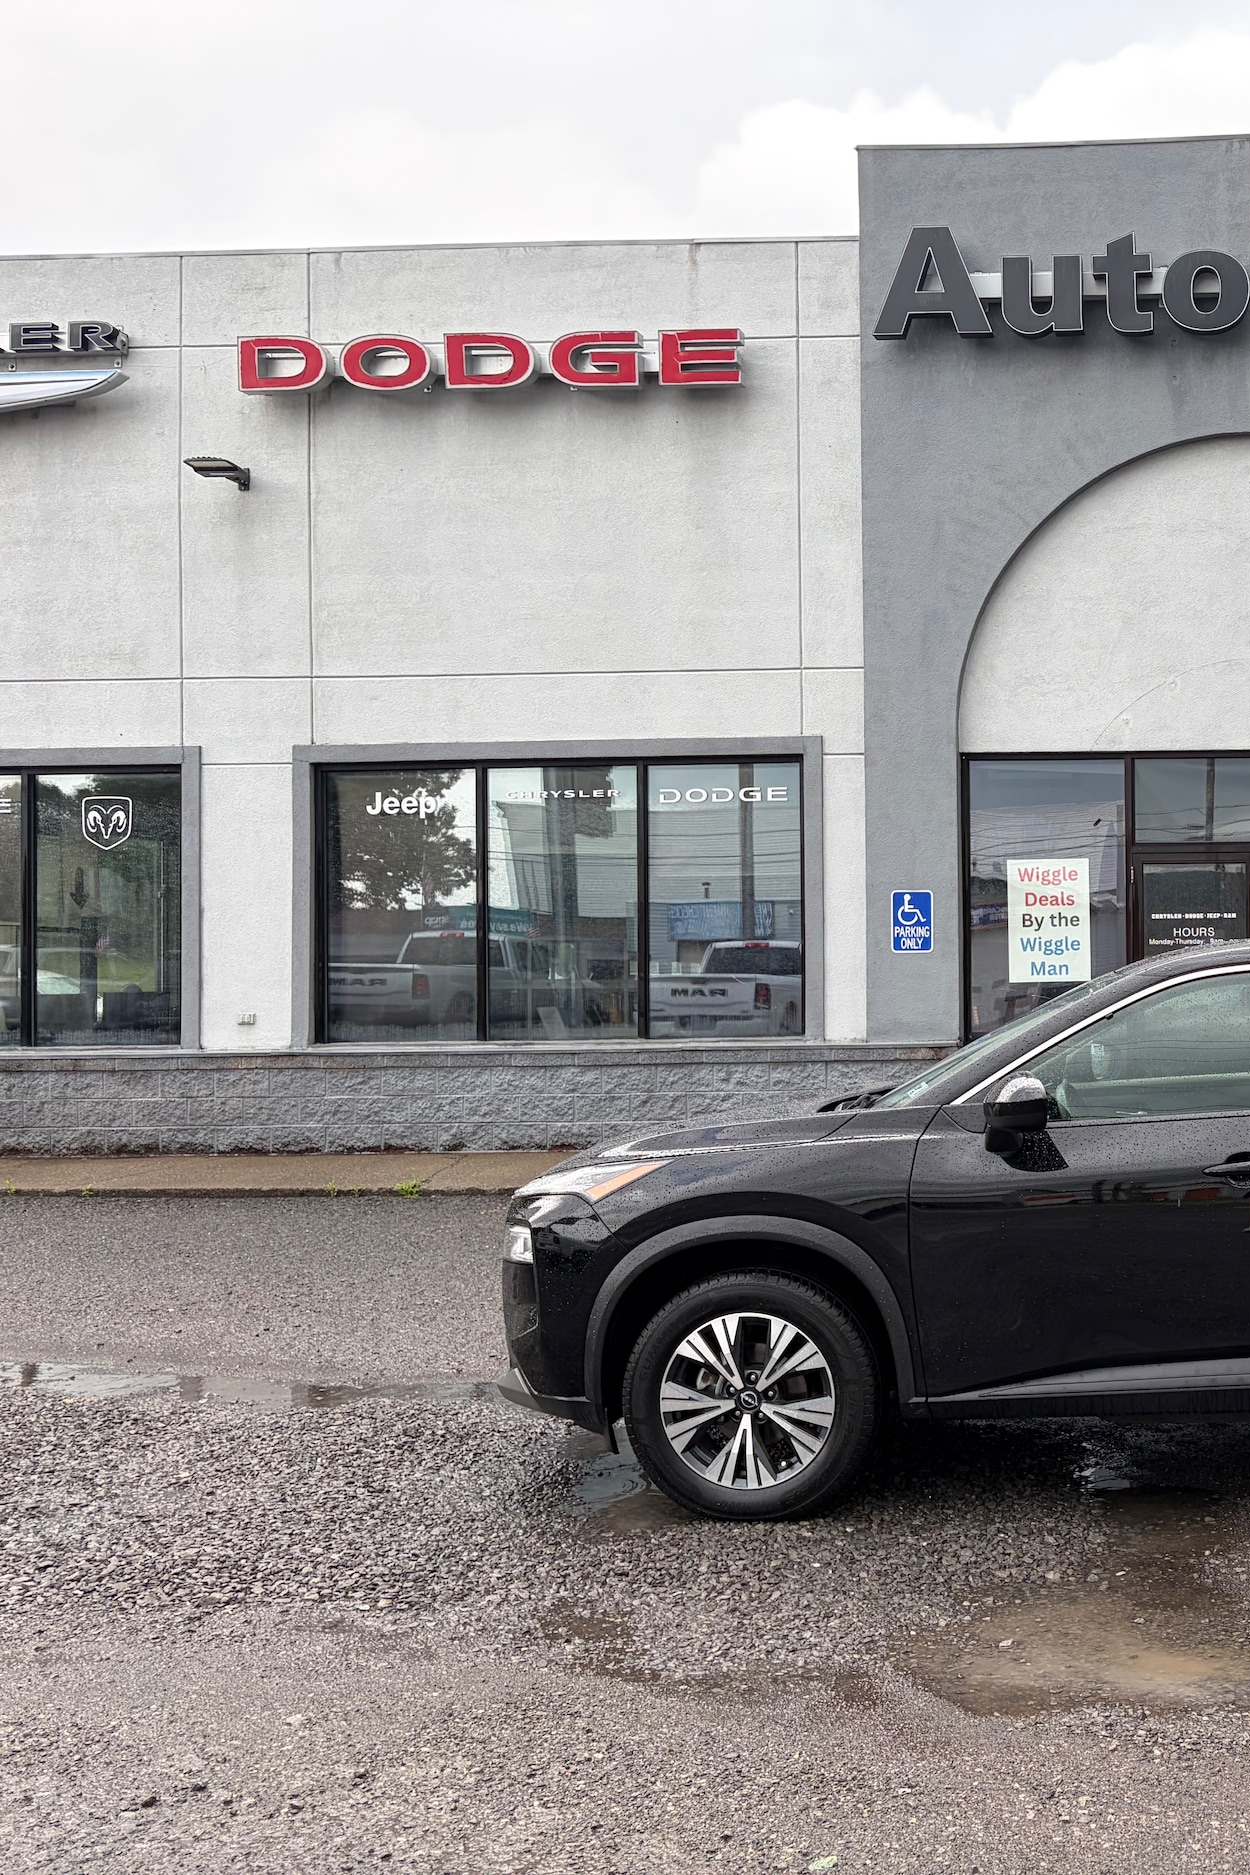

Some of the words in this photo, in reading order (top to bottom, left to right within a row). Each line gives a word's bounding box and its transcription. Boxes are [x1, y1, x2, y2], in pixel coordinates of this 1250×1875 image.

[873, 225, 1250, 340] Auto
[237, 328, 746, 396] DODGE
[505, 788, 621, 799] CHRYSLER
[659, 786, 789, 804] DODGE
[365, 791, 438, 819] Jeep
[1017, 866, 1079, 886] Wiggle
[1024, 891, 1075, 907] Deals
[1022, 913, 1045, 932] By
[1049, 911, 1080, 927] the
[894, 926, 930, 938] PARKING
[1173, 927, 1215, 937] HOURS
[900, 937, 924, 950] ONLY
[1020, 936, 1081, 956] Wiggle
[1030, 961, 1070, 976] Man
